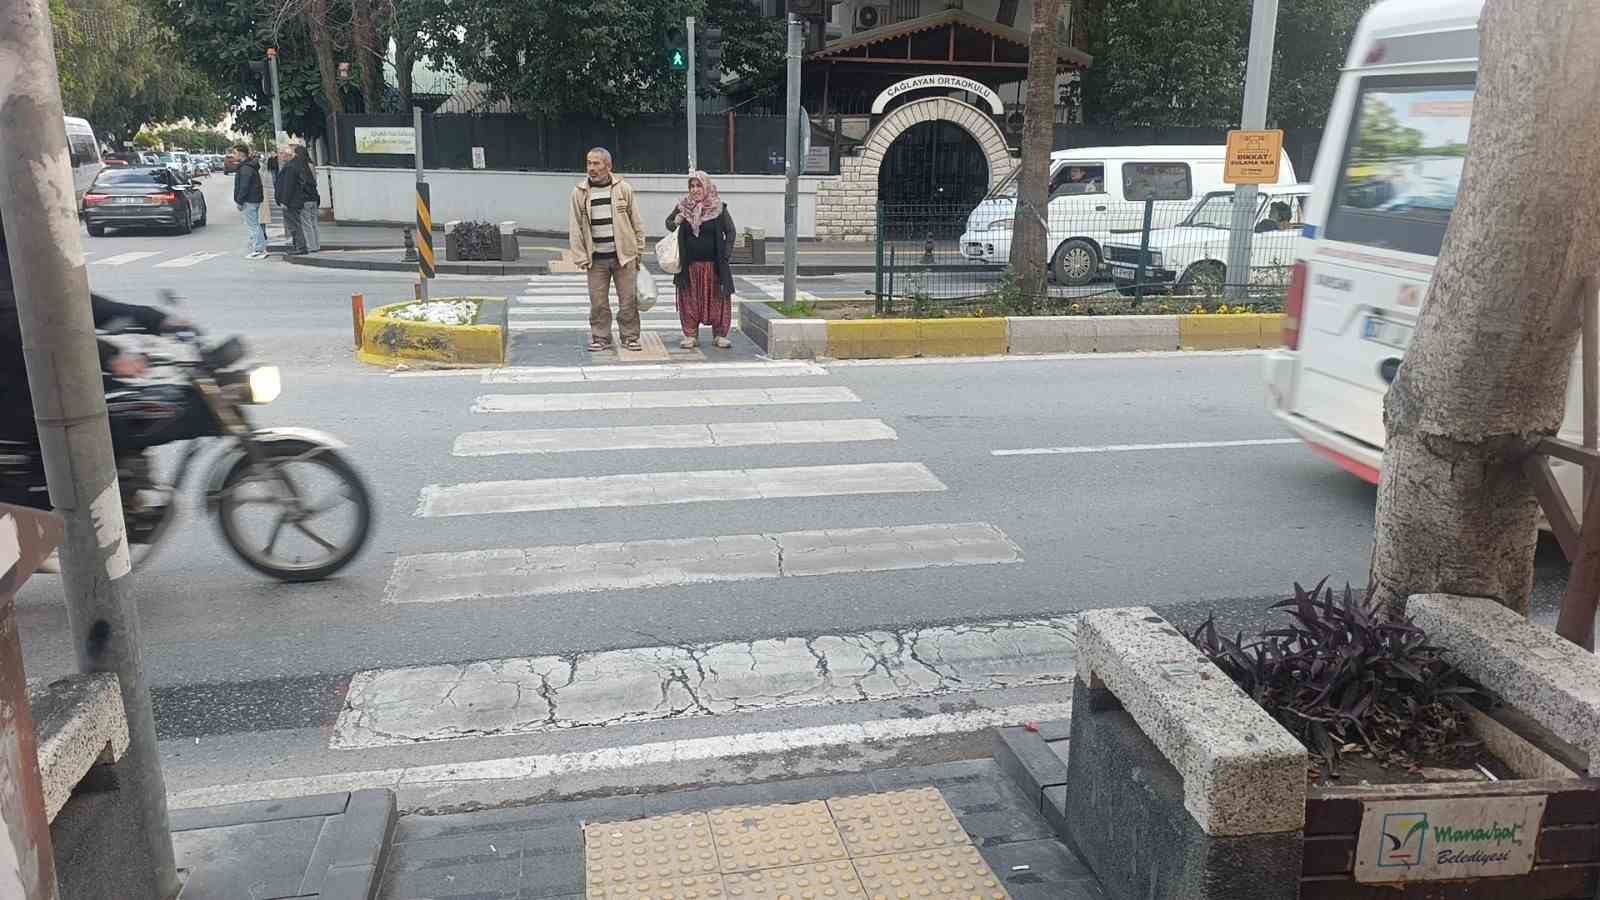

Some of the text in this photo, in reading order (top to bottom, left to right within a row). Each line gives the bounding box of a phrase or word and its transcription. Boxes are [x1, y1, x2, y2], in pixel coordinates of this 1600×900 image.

[887, 76, 991, 98] ÇAĞLAYAN ORTAOKULU
[1433, 821, 1522, 846] Manavgat
[1438, 849, 1510, 866] Belediyesi
